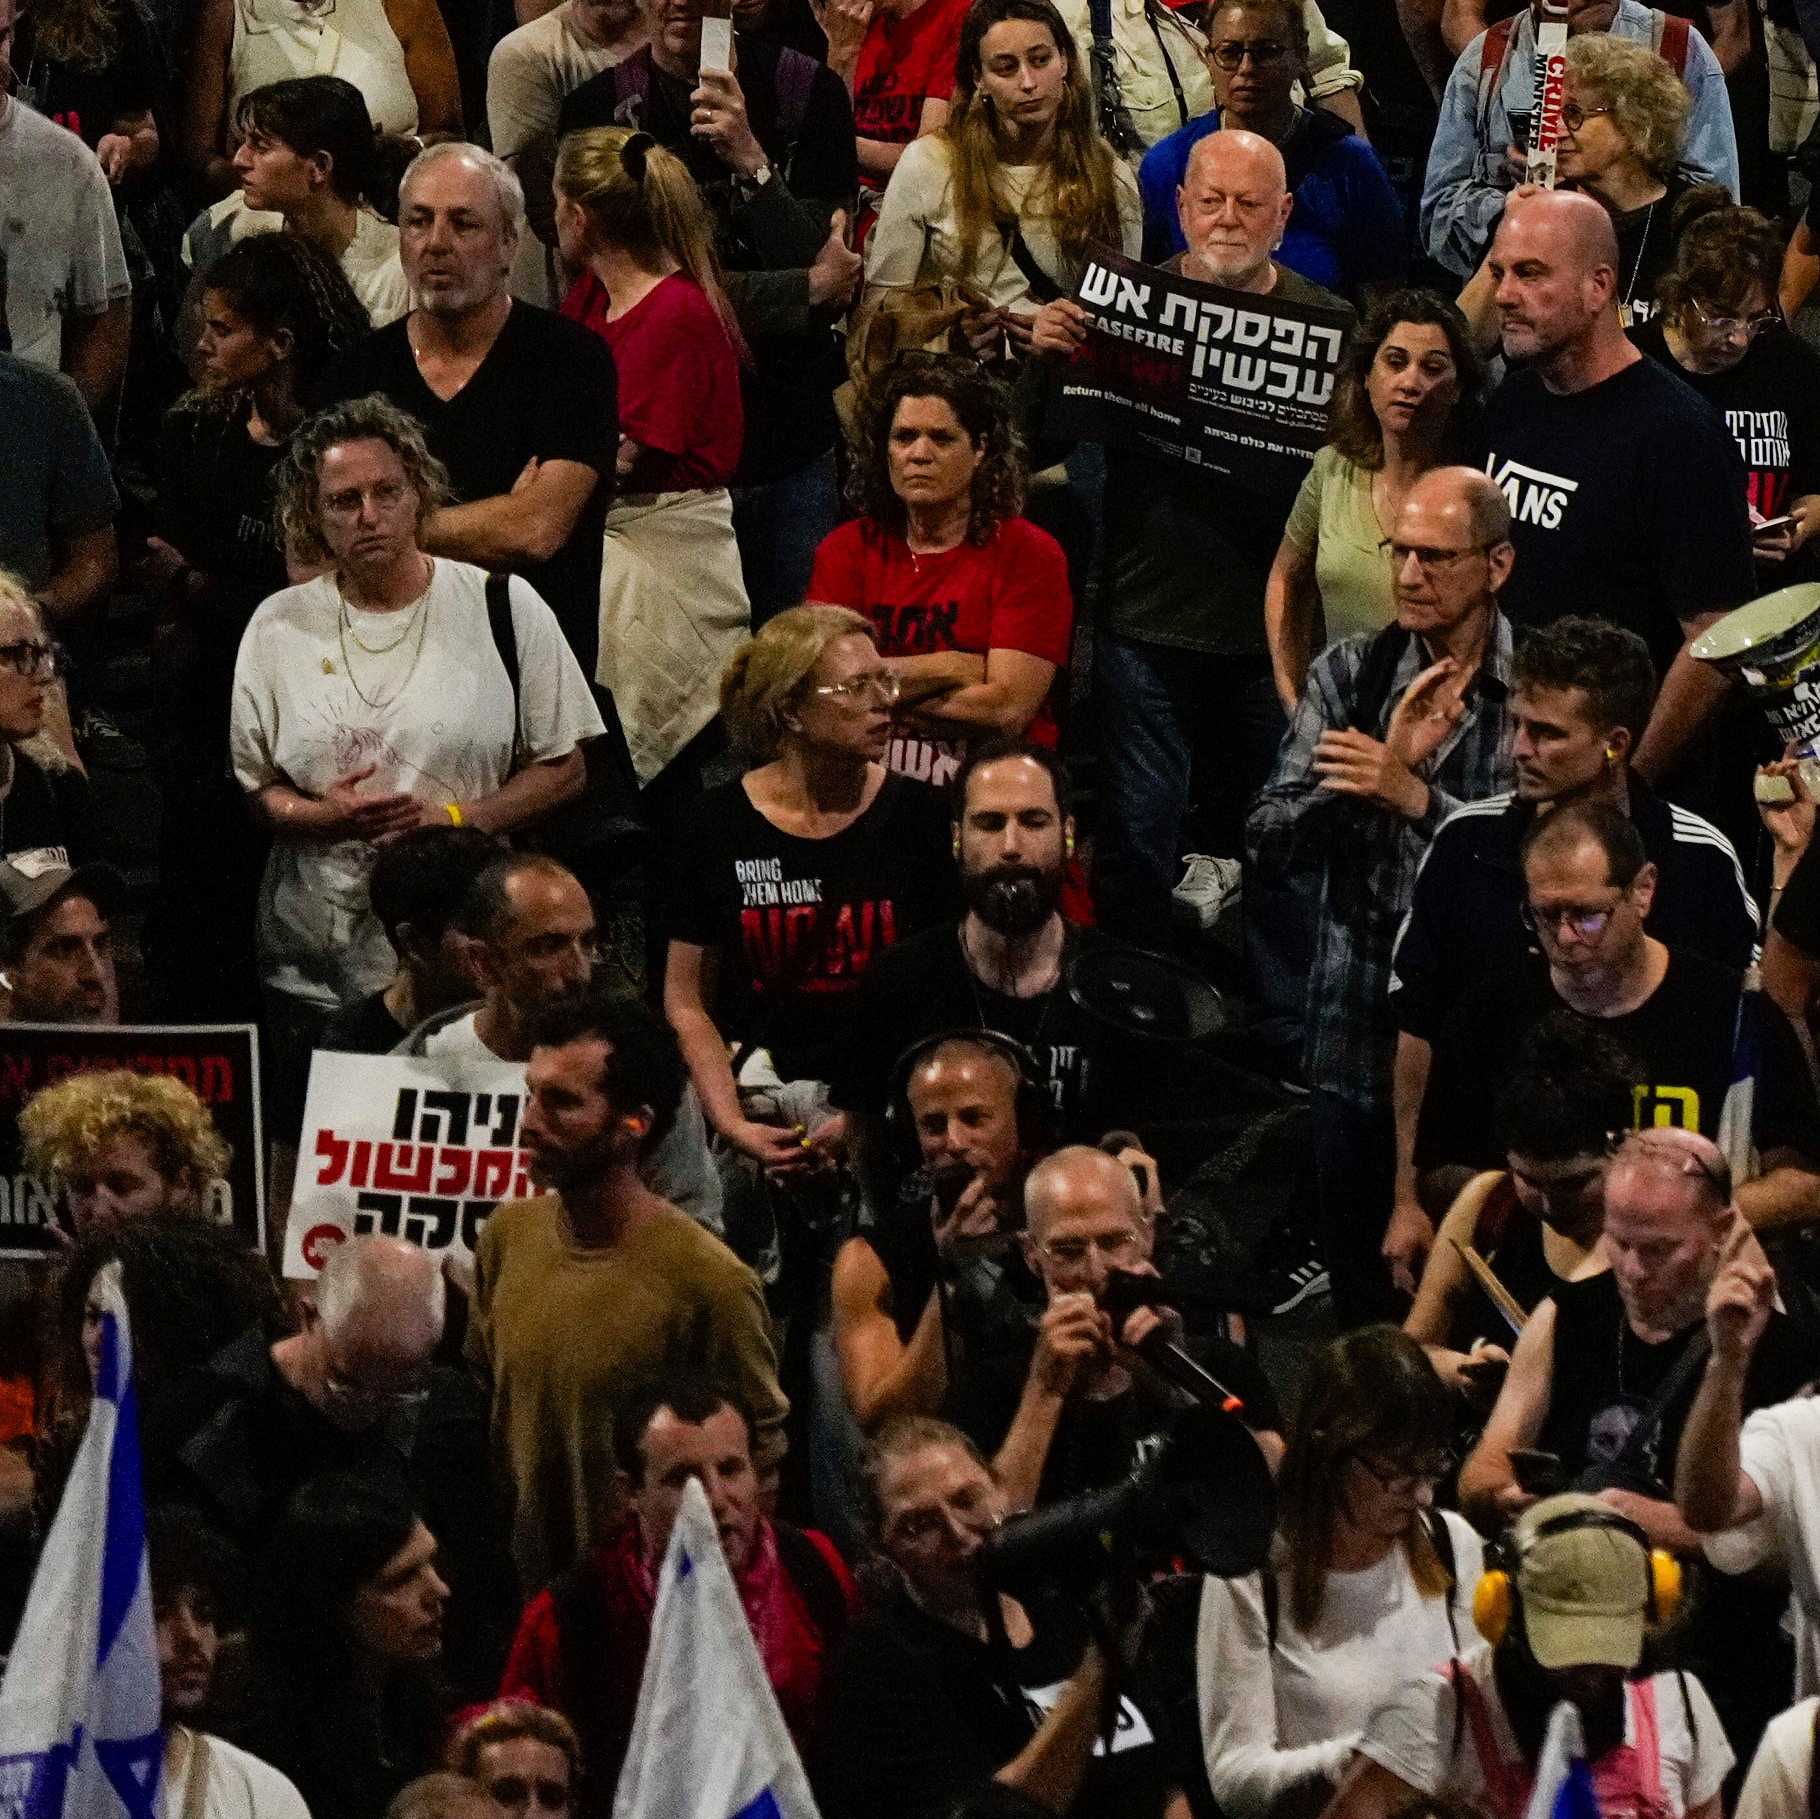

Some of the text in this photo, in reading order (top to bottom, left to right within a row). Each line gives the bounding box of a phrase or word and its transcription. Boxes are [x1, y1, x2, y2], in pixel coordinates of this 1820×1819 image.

[1527, 53, 1548, 150] MINISTER
[1539, 55, 1567, 152] CRIME
[1079, 262, 1151, 320] אש
[1078, 311, 1185, 357] EASEFIRE
[1159, 292, 1343, 364] הפסקת
[1063, 383, 1103, 398] Return
[1150, 405, 1182, 426] home
[1191, 342, 1335, 406] עכשיו
[1485, 451, 1580, 530] VANS
[734, 856, 782, 883] BRING
[394, 1086, 528, 1147] ניהו
